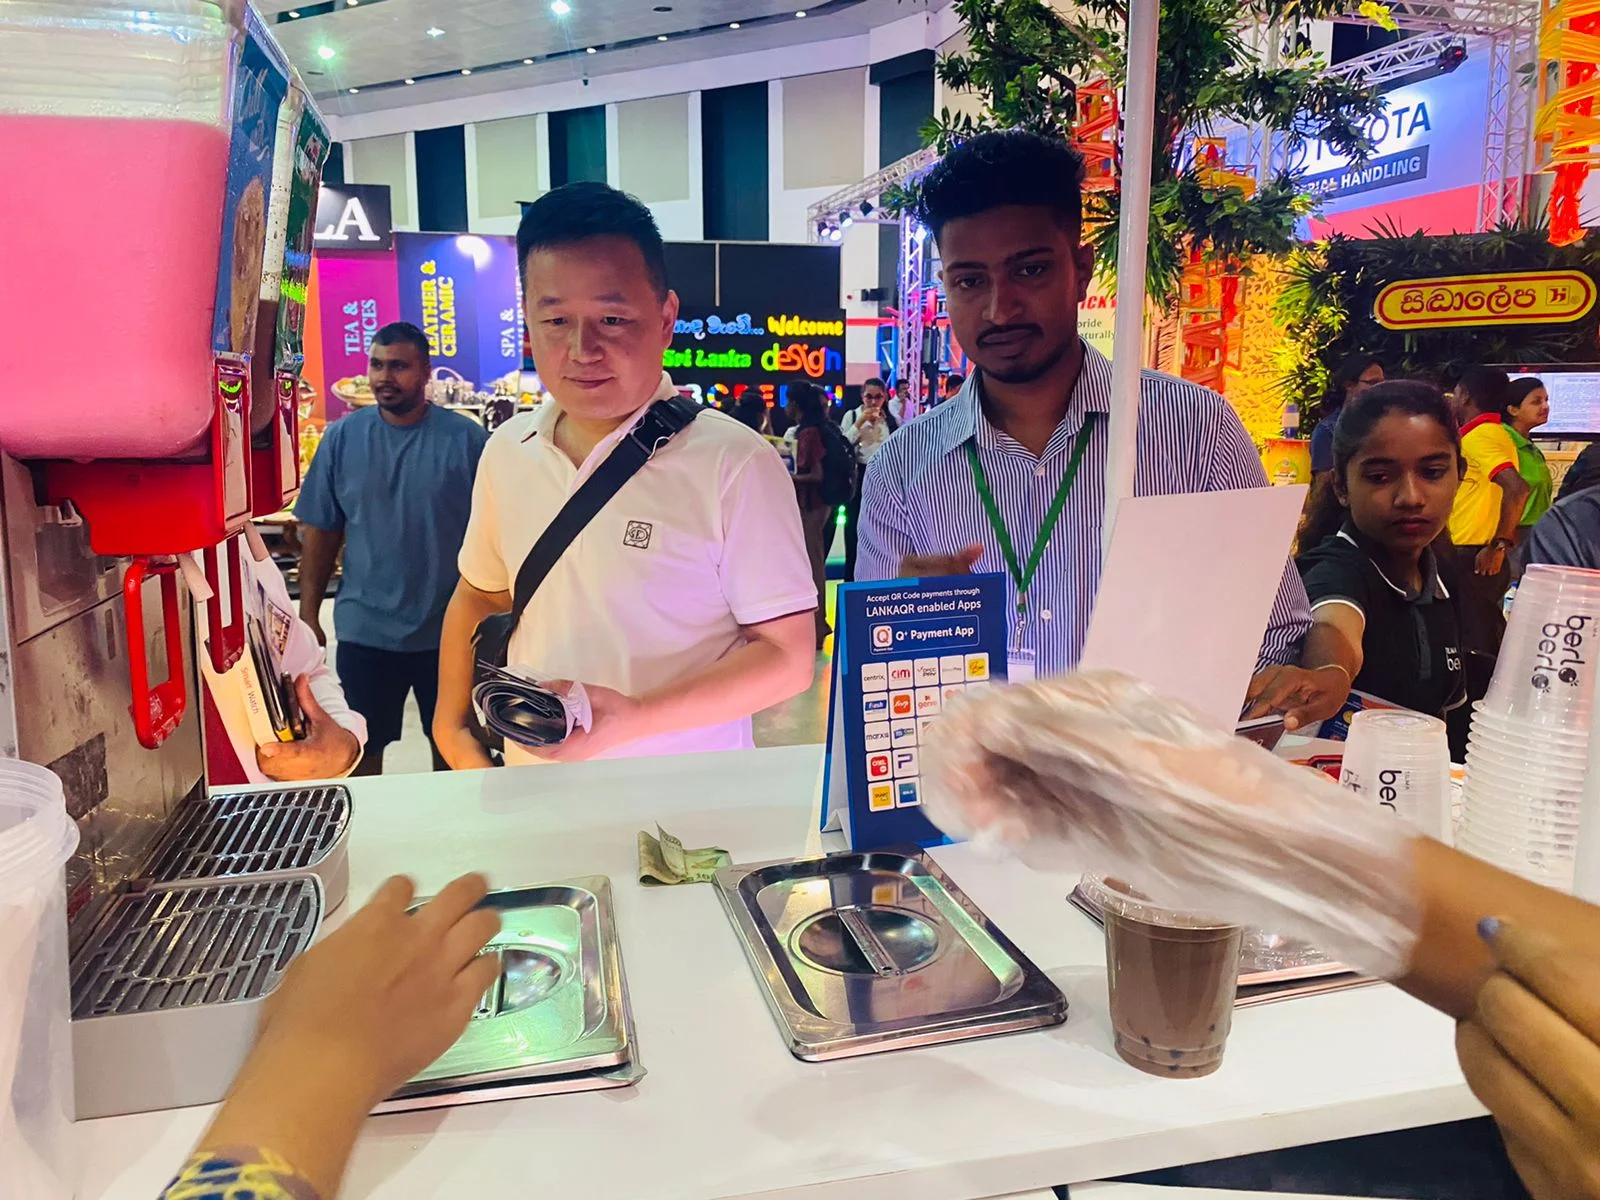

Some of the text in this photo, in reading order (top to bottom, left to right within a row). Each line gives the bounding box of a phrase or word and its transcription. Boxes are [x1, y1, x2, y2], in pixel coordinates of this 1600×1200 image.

[1341, 156, 1421, 189] HANDLING
[420, 260, 440, 356] LEATHER &
[438, 276, 457, 357] CERAMIC
[343, 301, 360, 356] TEA &
[500, 308, 516, 358] SPA &
[767, 314, 844, 336] Welcome
[663, 343, 841, 377] Sri Lanka design
[866, 595, 890, 603] Accept
[903, 591, 920, 600] Code
[921, 590, 953, 600] payments
[954, 587, 980, 597] through
[866, 599, 982, 617] LANKAQR enabled Apps
[910, 627, 953, 641] Payment
[954, 625, 974, 637] App
[1446, 654, 1461, 671] be
[1379, 770, 1402, 812] ber
